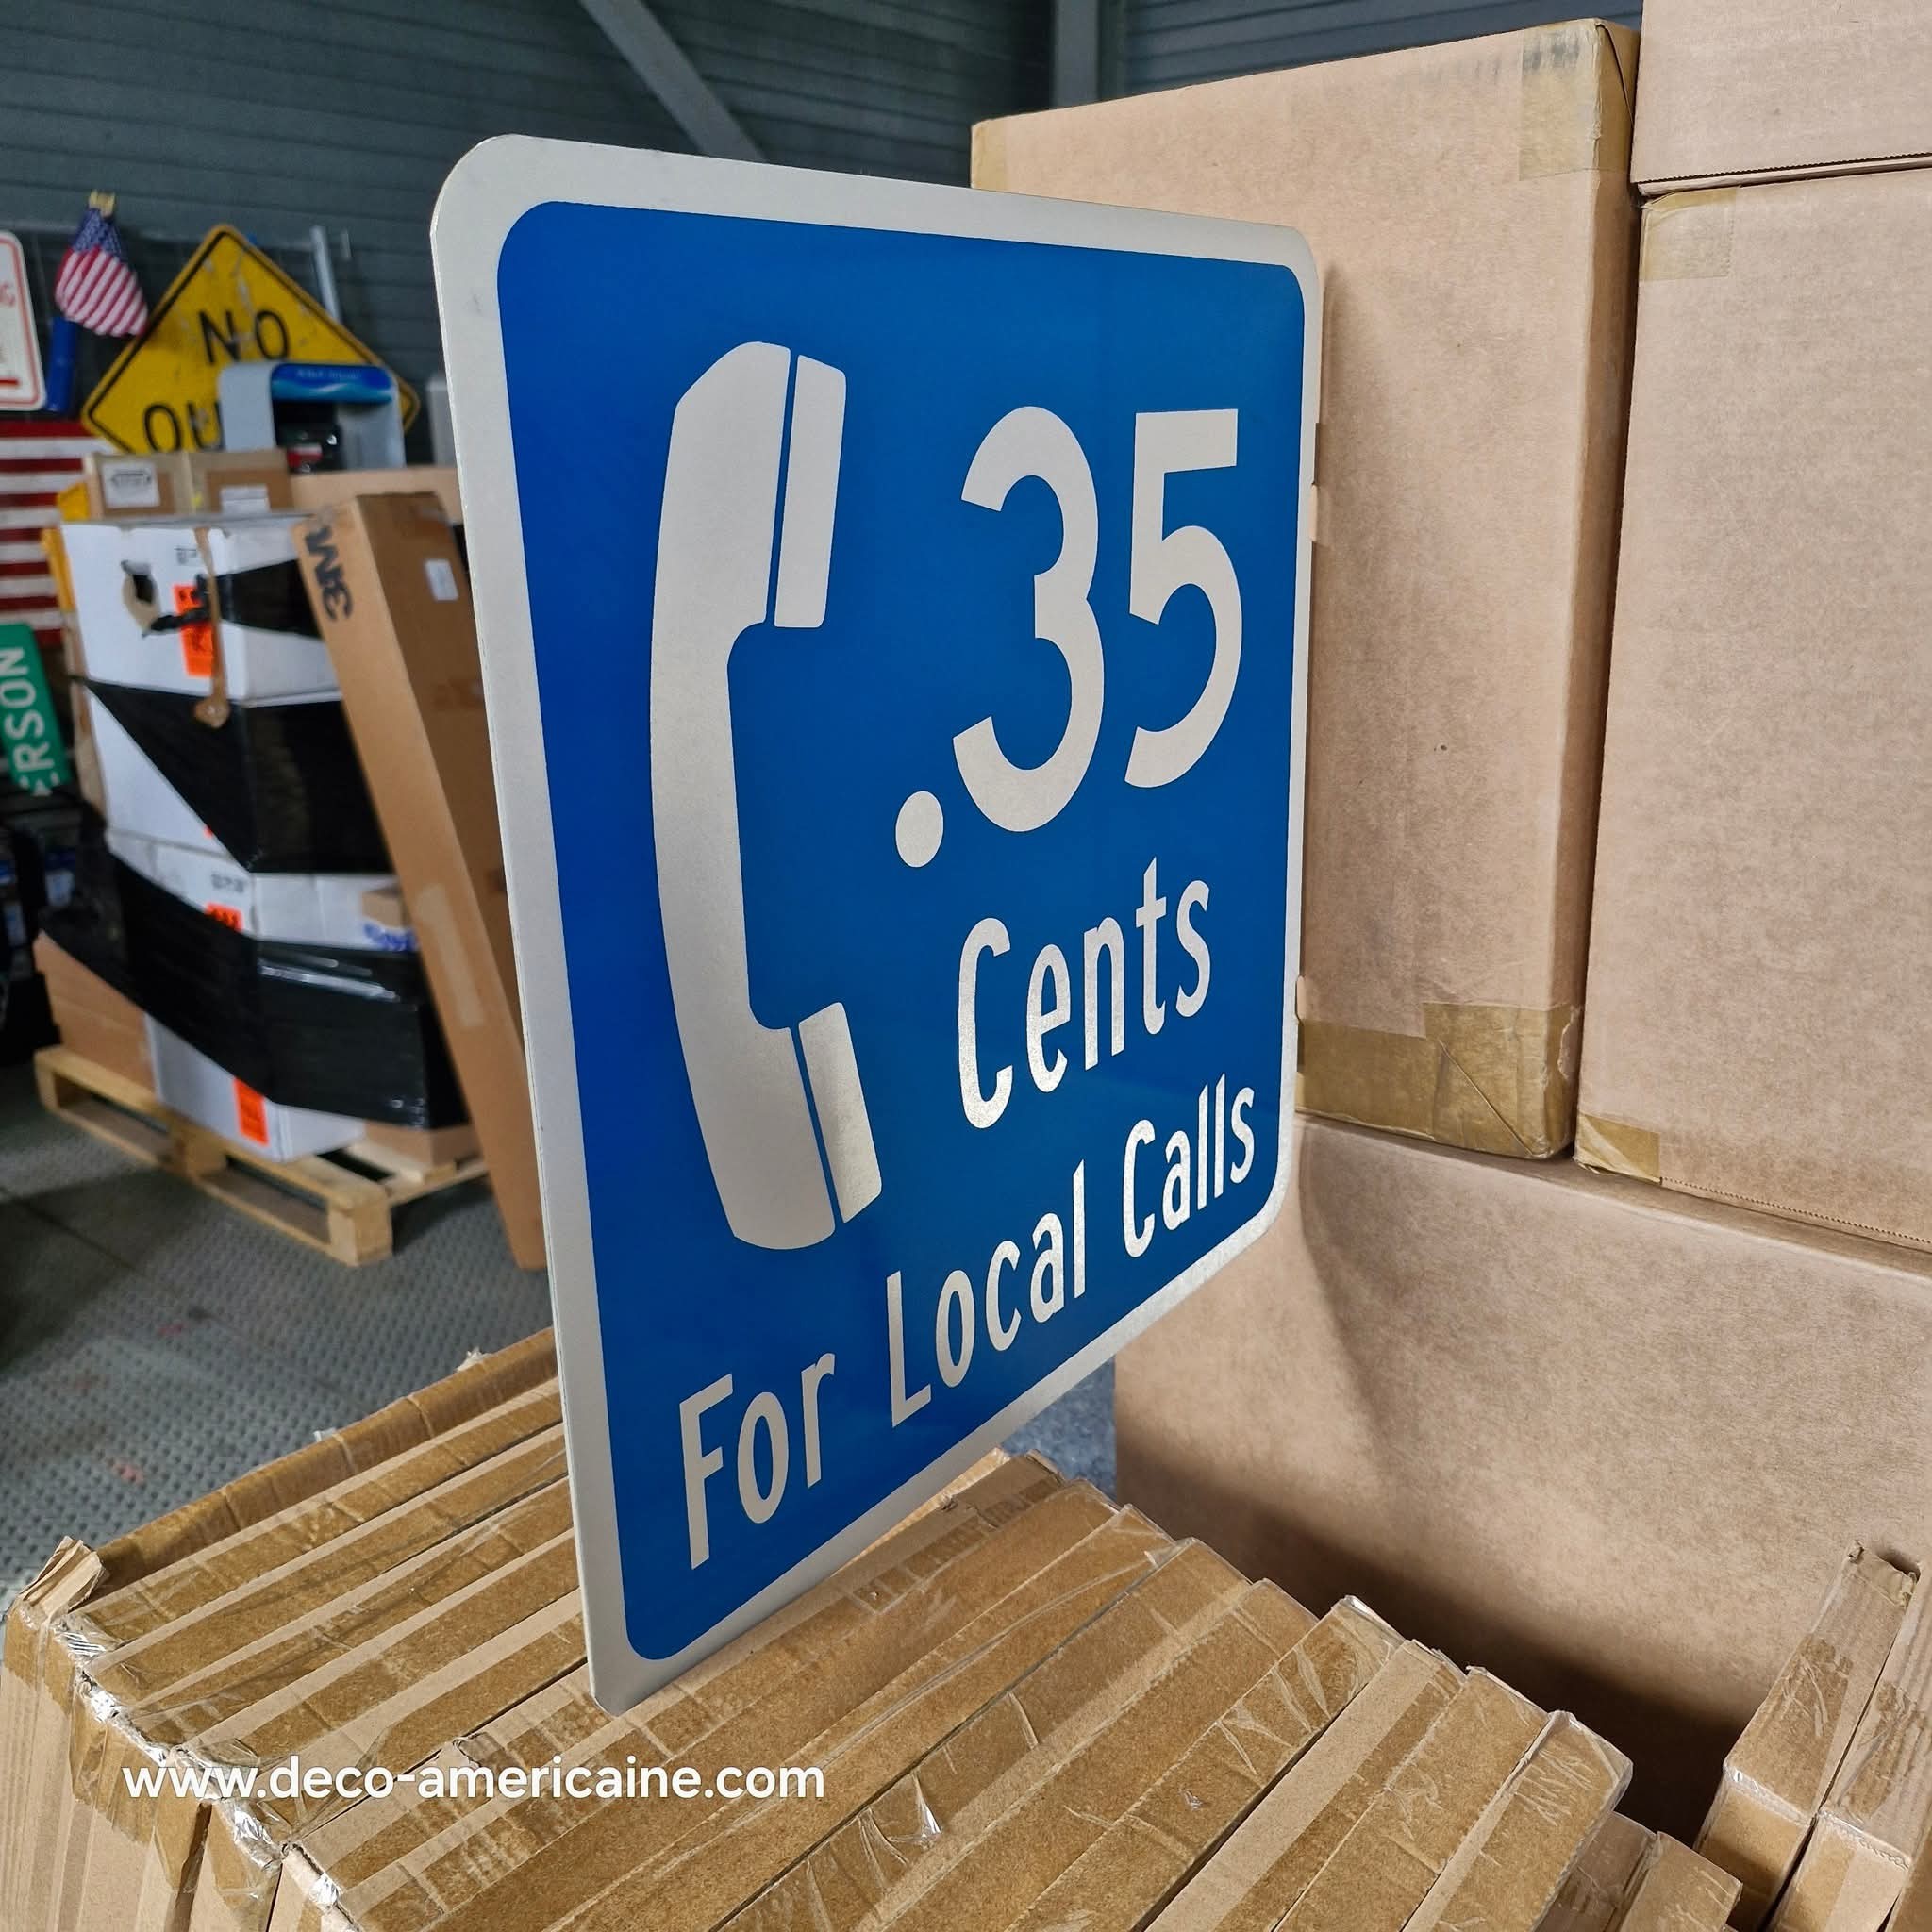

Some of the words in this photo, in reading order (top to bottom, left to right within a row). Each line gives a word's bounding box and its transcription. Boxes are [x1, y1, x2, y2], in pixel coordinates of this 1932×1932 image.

[143, 399, 226, 453] OU
[198, 308, 291, 364] NO
[894, 406, 1243, 868] .35
[958, 857, 1211, 1129] Cents
[679, 1352, 836, 1570] For
[886, 1159, 1086, 1427] Local
[1123, 1073, 1255, 1258] Calls
